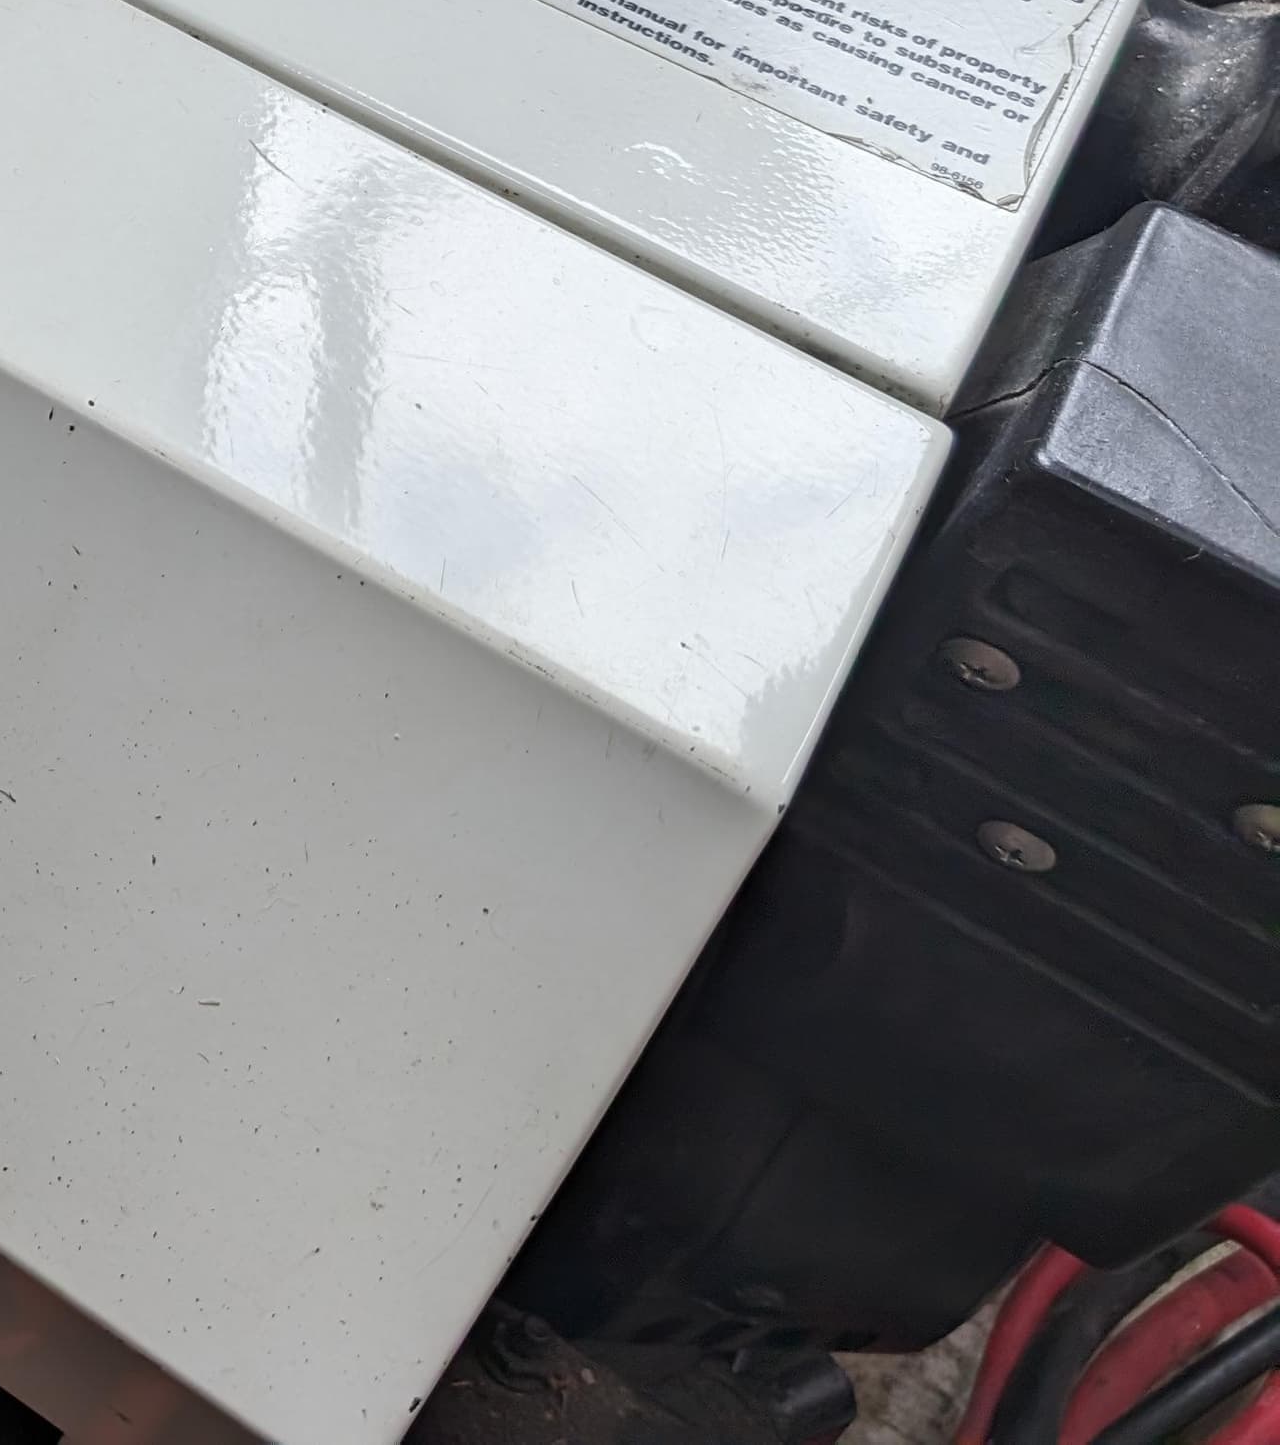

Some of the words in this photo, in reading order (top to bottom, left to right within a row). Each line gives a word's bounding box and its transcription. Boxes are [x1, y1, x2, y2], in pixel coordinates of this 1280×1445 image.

[850, 9, 908, 38] risks
[911, 34, 938, 49] of
[938, 45, 1047, 94] property
[863, 30, 886, 47] to
[894, 46, 1035, 107] substances
[692, 29, 726, 50] for
[731, 45, 847, 106] important
[854, 101, 933, 143] safety
[941, 140, 990, 165] and
[931, 162, 984, 190] 98-6156
